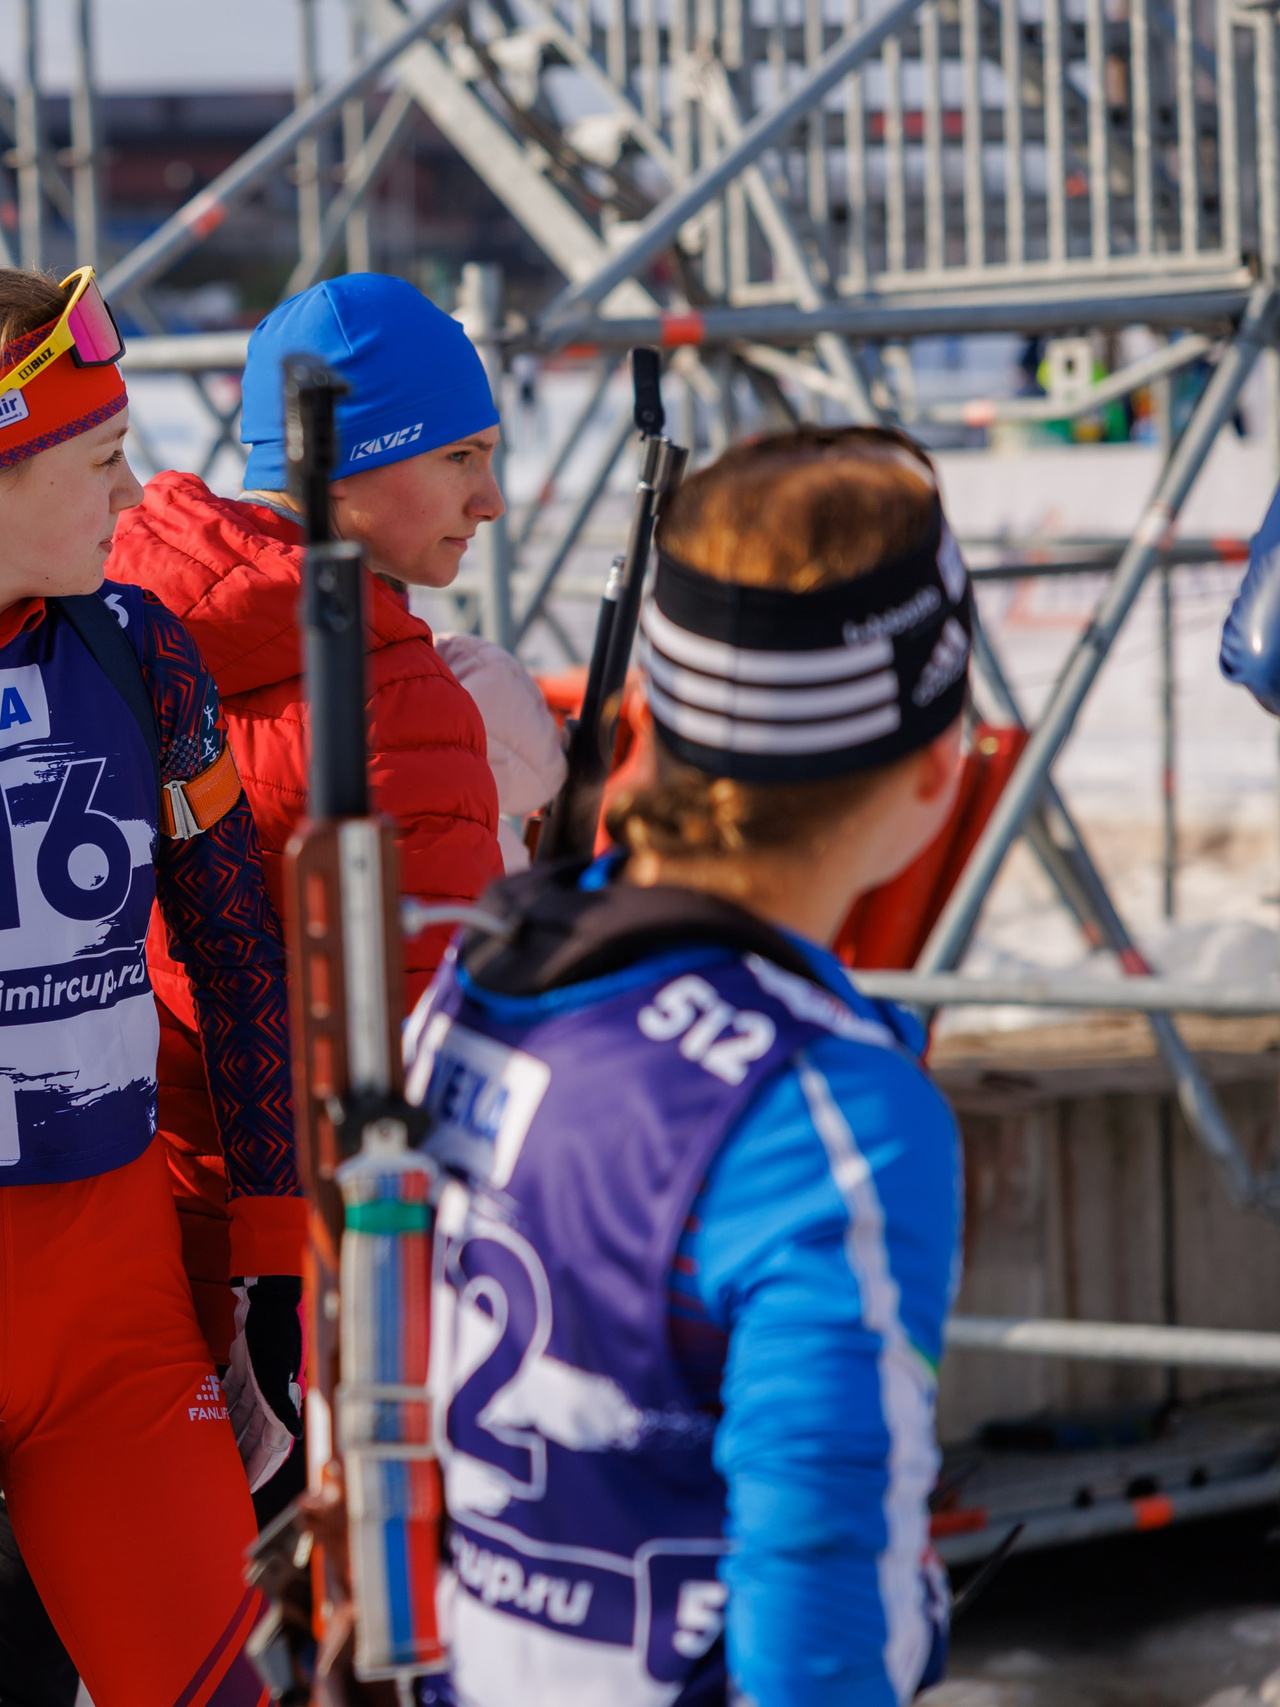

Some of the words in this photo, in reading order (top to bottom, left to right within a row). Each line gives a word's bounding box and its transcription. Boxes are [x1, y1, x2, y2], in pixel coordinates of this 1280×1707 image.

[30, 346, 55, 371] BLIZ
[349, 422, 424, 461] KV+
[636, 973, 777, 1086] 512
